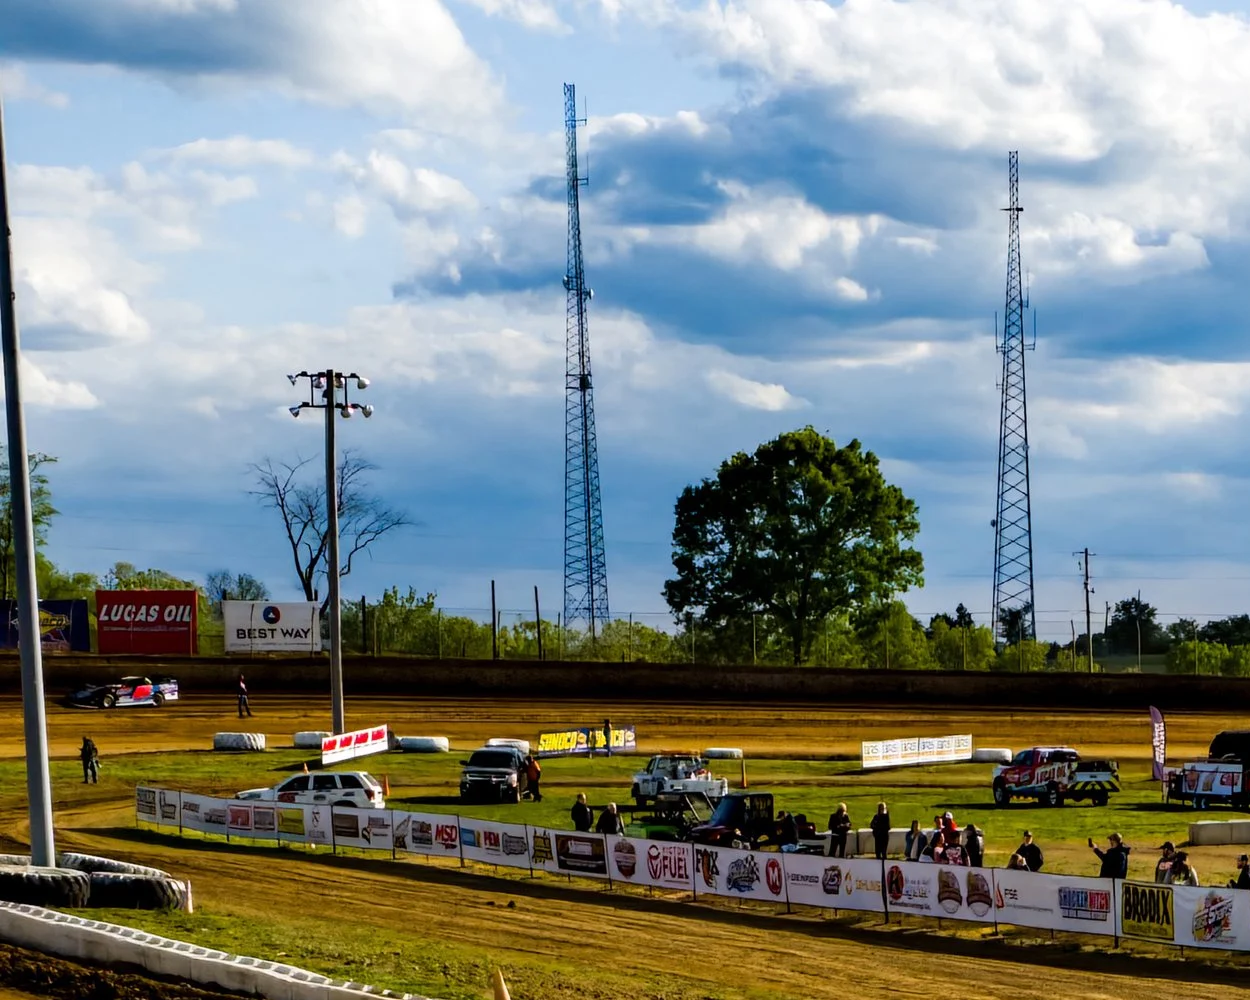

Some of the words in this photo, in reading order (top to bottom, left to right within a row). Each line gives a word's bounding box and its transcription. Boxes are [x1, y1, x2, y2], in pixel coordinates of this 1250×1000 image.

[99, 604, 160, 622] LUCAS
[164, 605, 191, 622] OIL
[236, 628, 277, 639] BEST
[281, 628, 310, 639] WAY
[435, 823, 458, 843] MSD
[662, 854, 689, 880] FUEL
[1124, 884, 1171, 926] BRODIX
